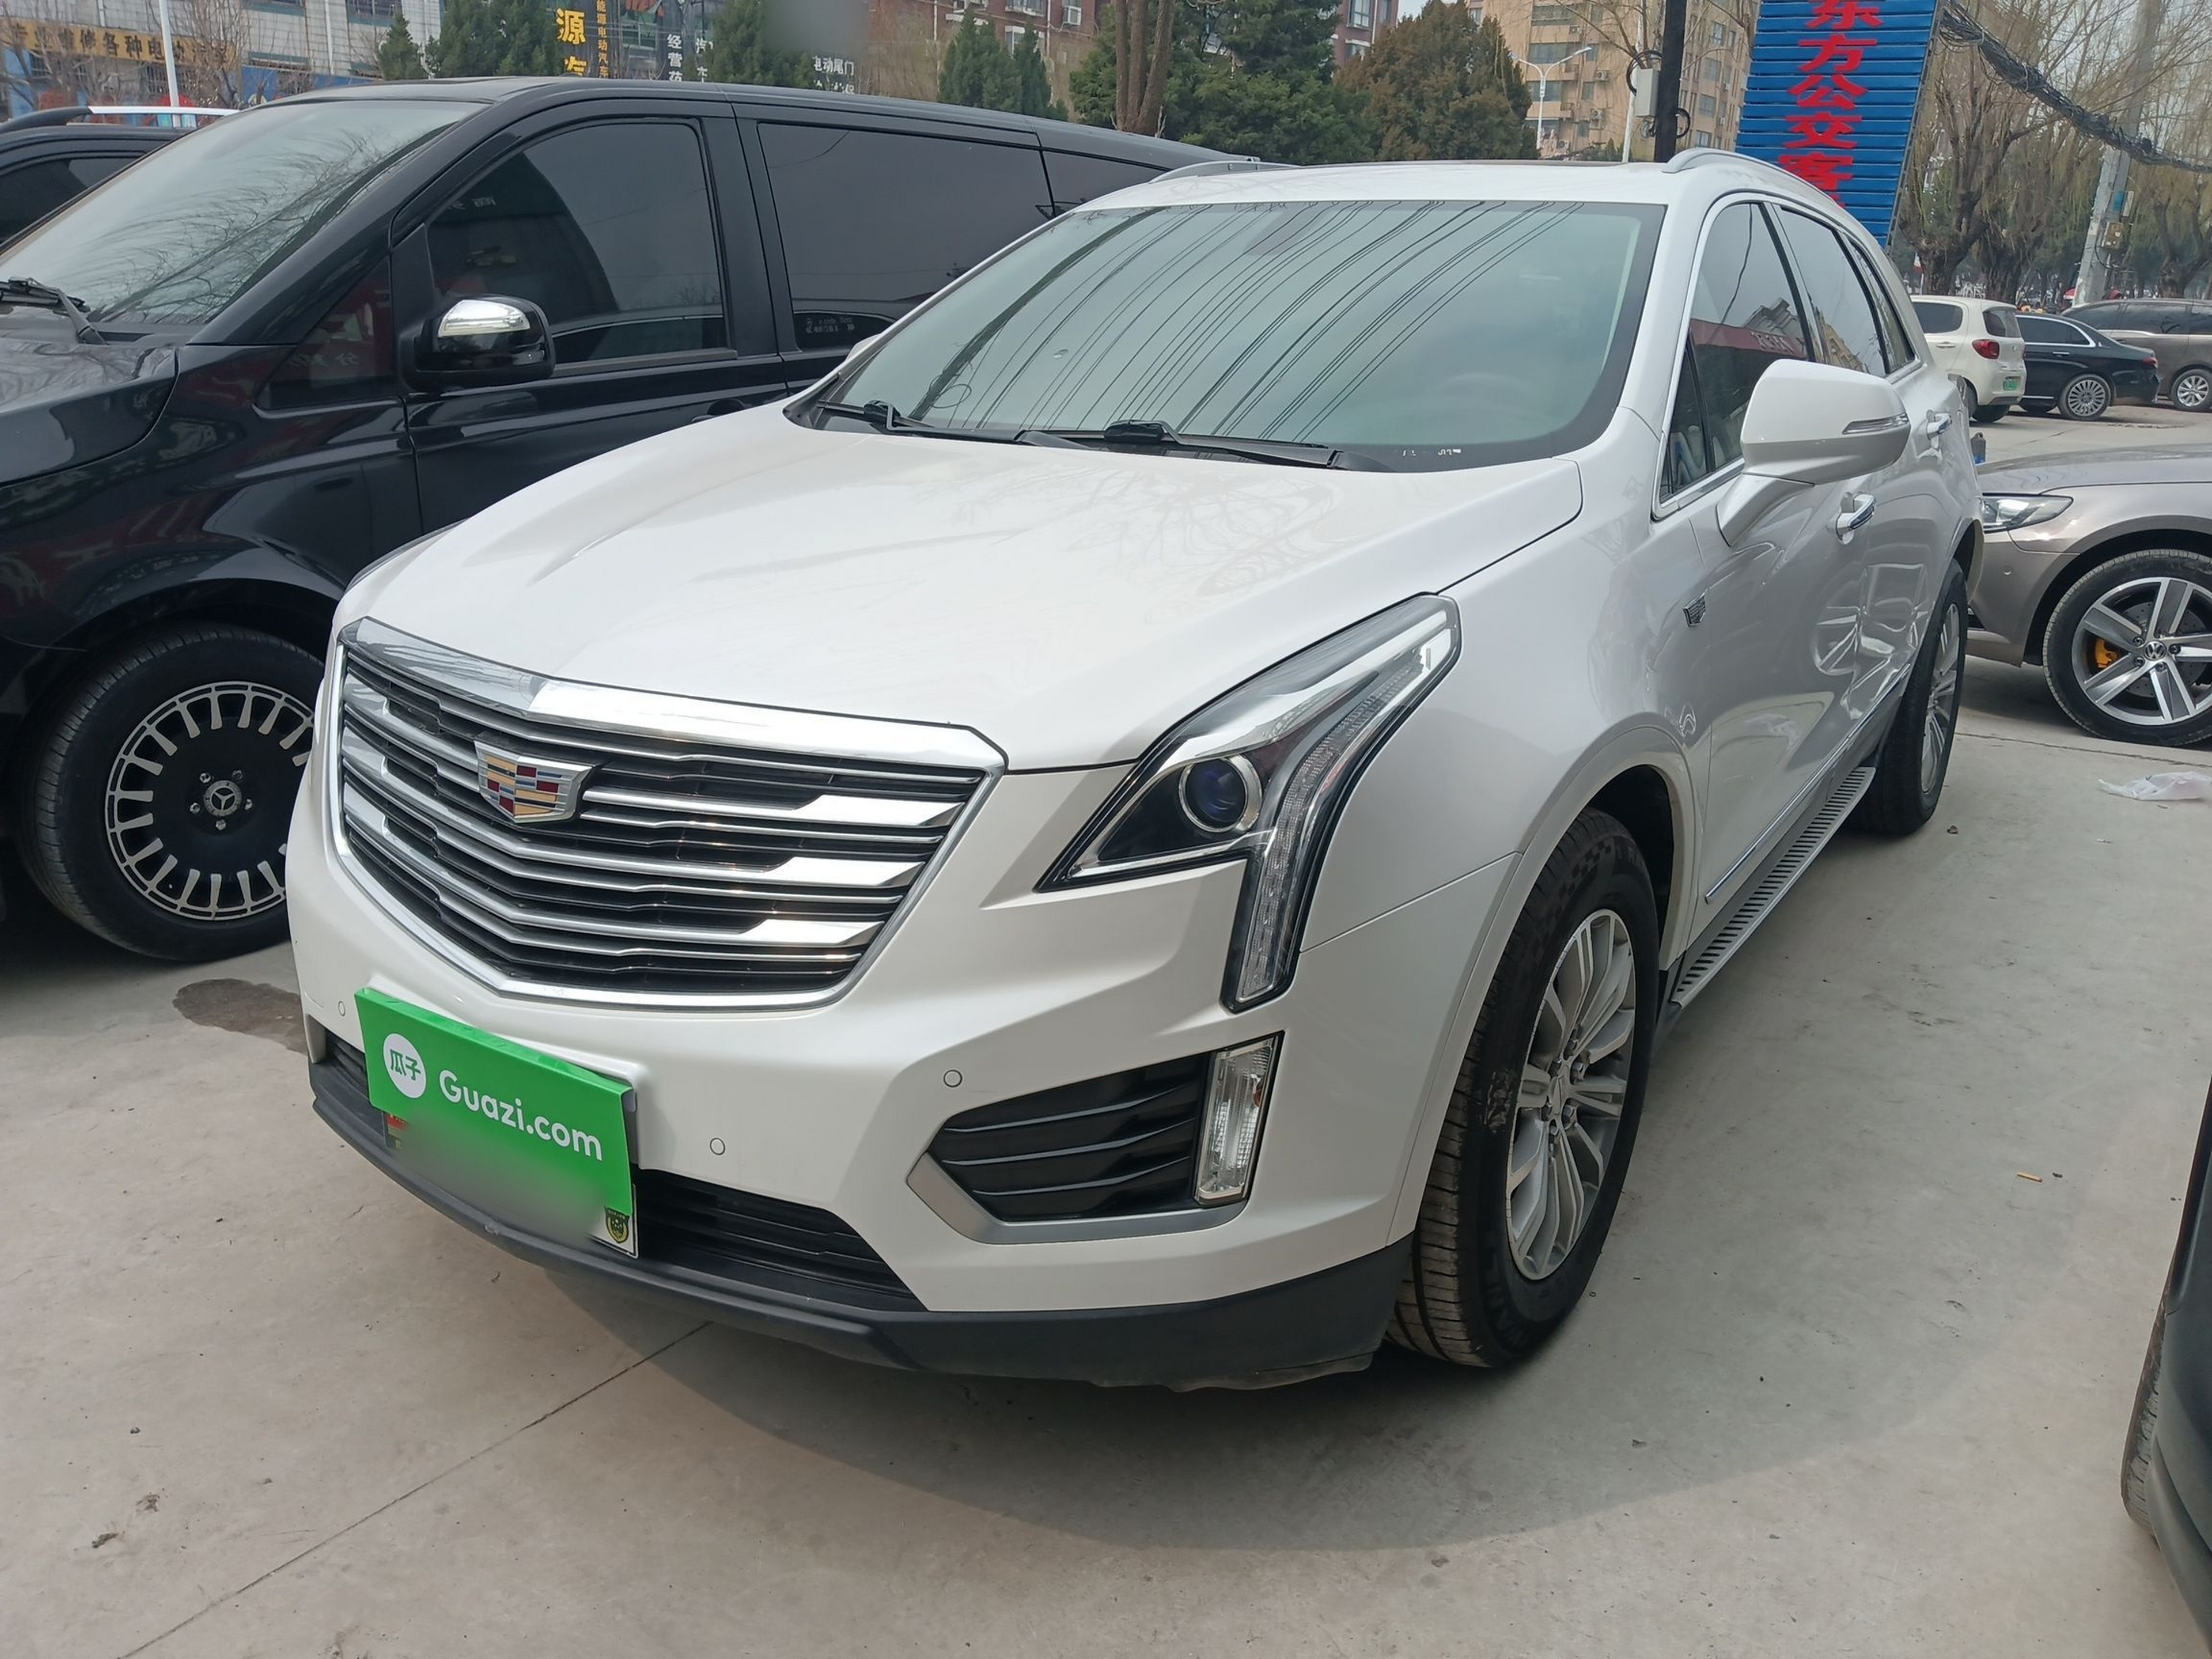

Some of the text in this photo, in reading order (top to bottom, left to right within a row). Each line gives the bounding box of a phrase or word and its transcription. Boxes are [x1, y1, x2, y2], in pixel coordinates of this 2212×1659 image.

[1779, 0, 1882, 207] 东方公交客
[389, 1049, 421, 1081] 瓜子
[439, 1069, 603, 1161] Guazi.com
